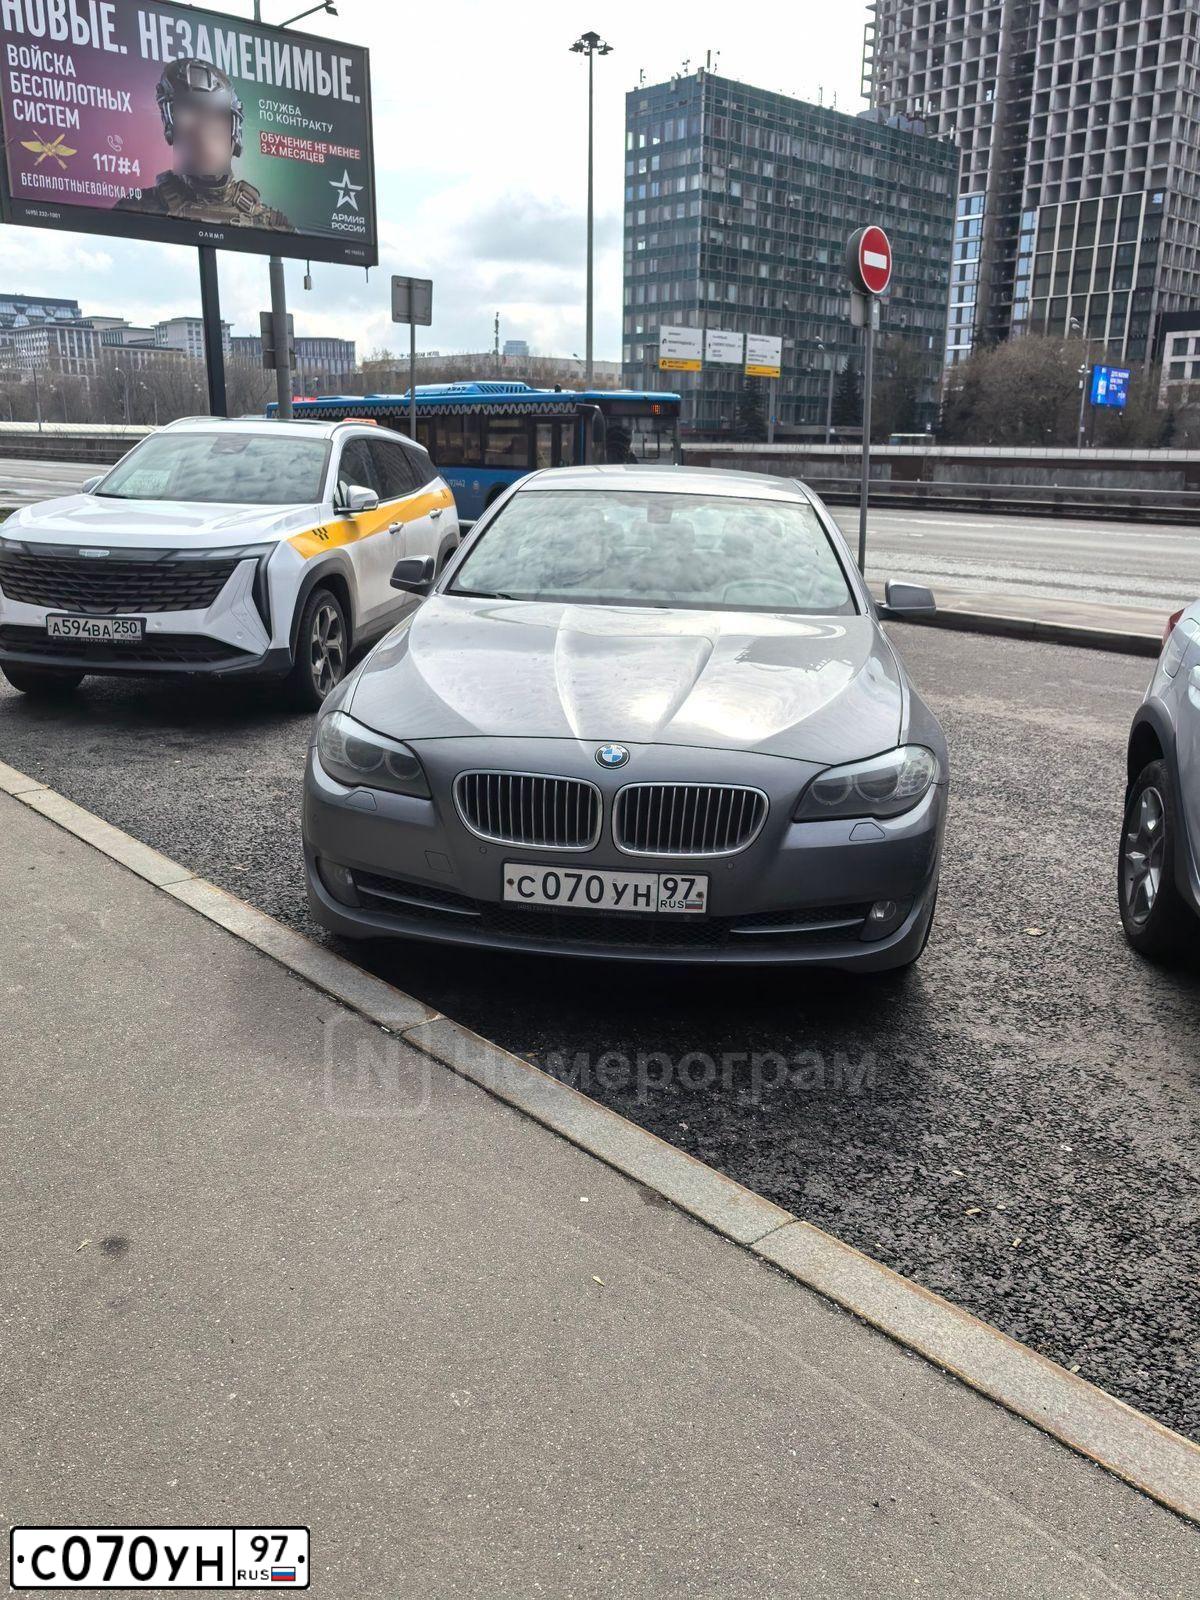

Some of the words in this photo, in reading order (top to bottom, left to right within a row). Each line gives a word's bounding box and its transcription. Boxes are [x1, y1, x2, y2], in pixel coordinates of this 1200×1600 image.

[1, 0, 128, 54] НОВЫЕ.
[137, 10, 361, 104] НЕЗАМЕНИМЫЕ.
[6, 43, 77, 78] ВОЙСКА
[9, 71, 133, 114] БЕСПИЛОТНЫХ
[12, 98, 80, 130] СИСТЕМ
[258, 99, 301, 116] СЛУЖБА
[259, 110, 274, 121] ПО
[276, 114, 333, 133] КОНТРАКТУ
[260, 132, 313, 151] ОБУЧЕНИЕ
[314, 143, 327, 153] НЕ
[329, 145, 361, 160] МЕНЕЕ
[279, 147, 326, 164] МЕСЯЦЕВ
[92, 152, 141, 177] 117#4
[20, 172, 143, 201] БЕСПИЛОТНЫЕВОЙСКА.РФ
[331, 212, 366, 225] АРМИЯ
[331, 221, 366, 233] РОССИИ
[53, 619, 111, 637] А594ВА
[114, 621, 137, 634] 250
[516, 871, 651, 907] С070УН
[662, 877, 696, 900] 97
[660, 899, 685, 909] RUS
